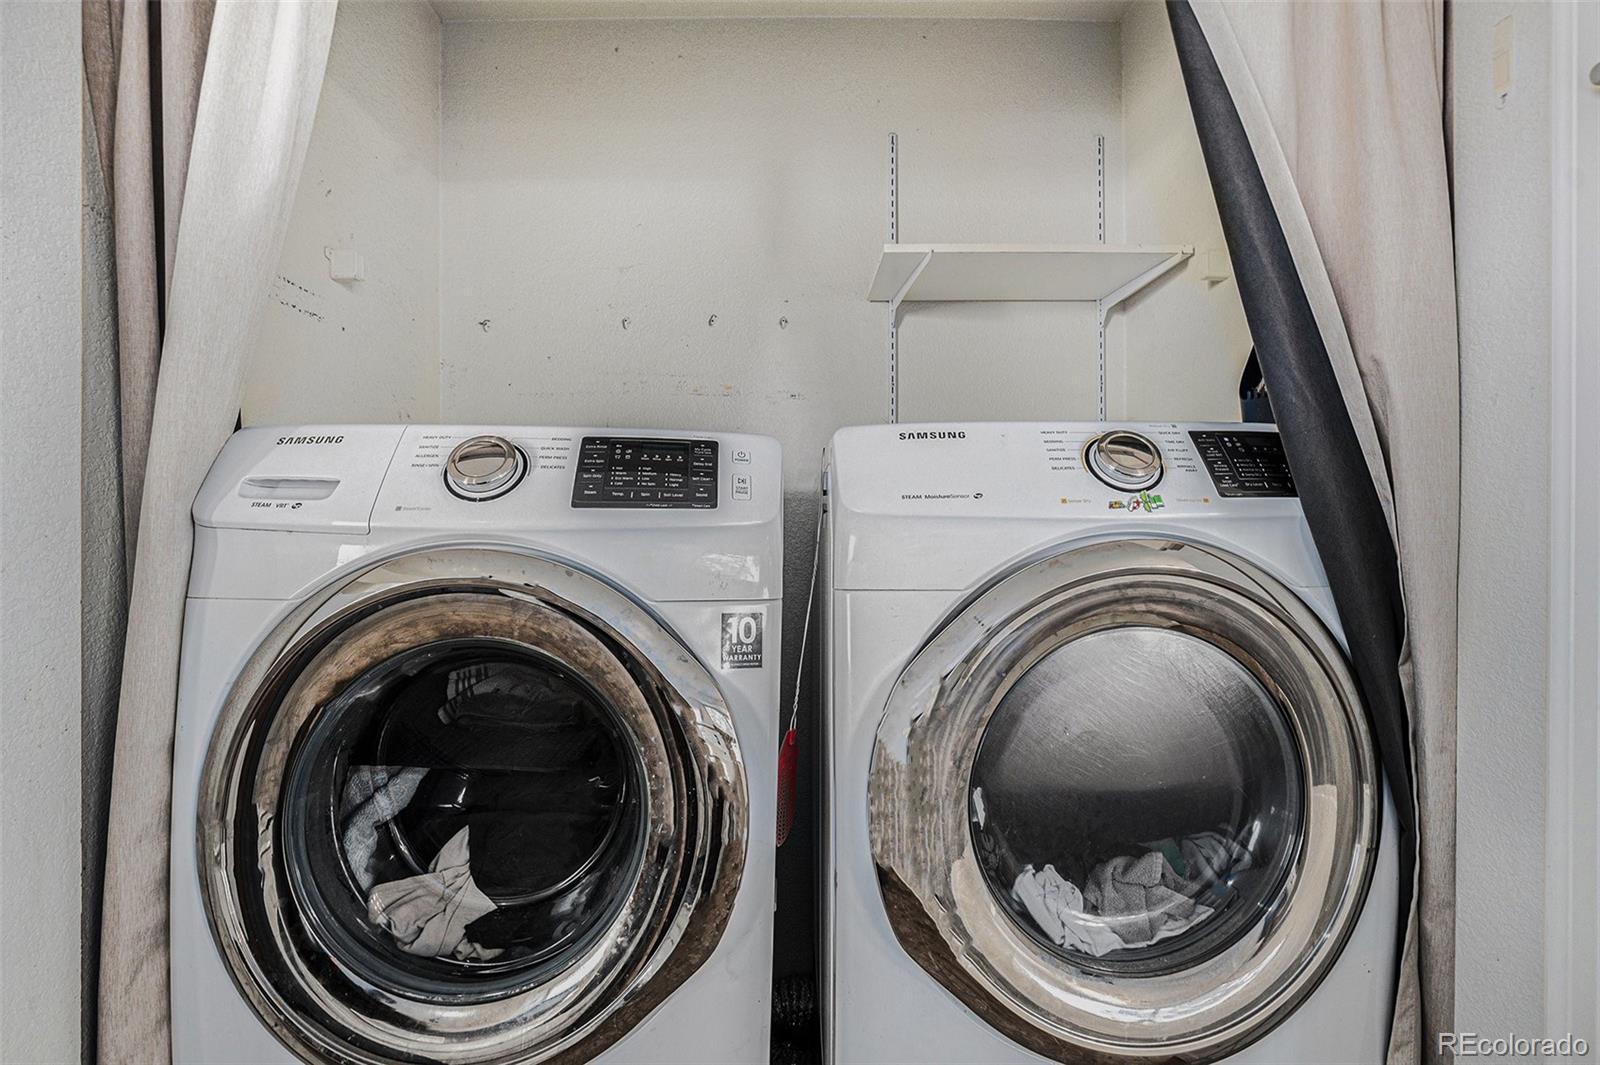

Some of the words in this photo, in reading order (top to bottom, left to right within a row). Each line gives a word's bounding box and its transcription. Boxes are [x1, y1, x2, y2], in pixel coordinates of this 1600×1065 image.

[276, 435, 344, 445] SAMSUNG
[899, 431, 966, 440] SAMSUNG
[727, 616, 757, 644] 10
[731, 644, 753, 653] YEAR
